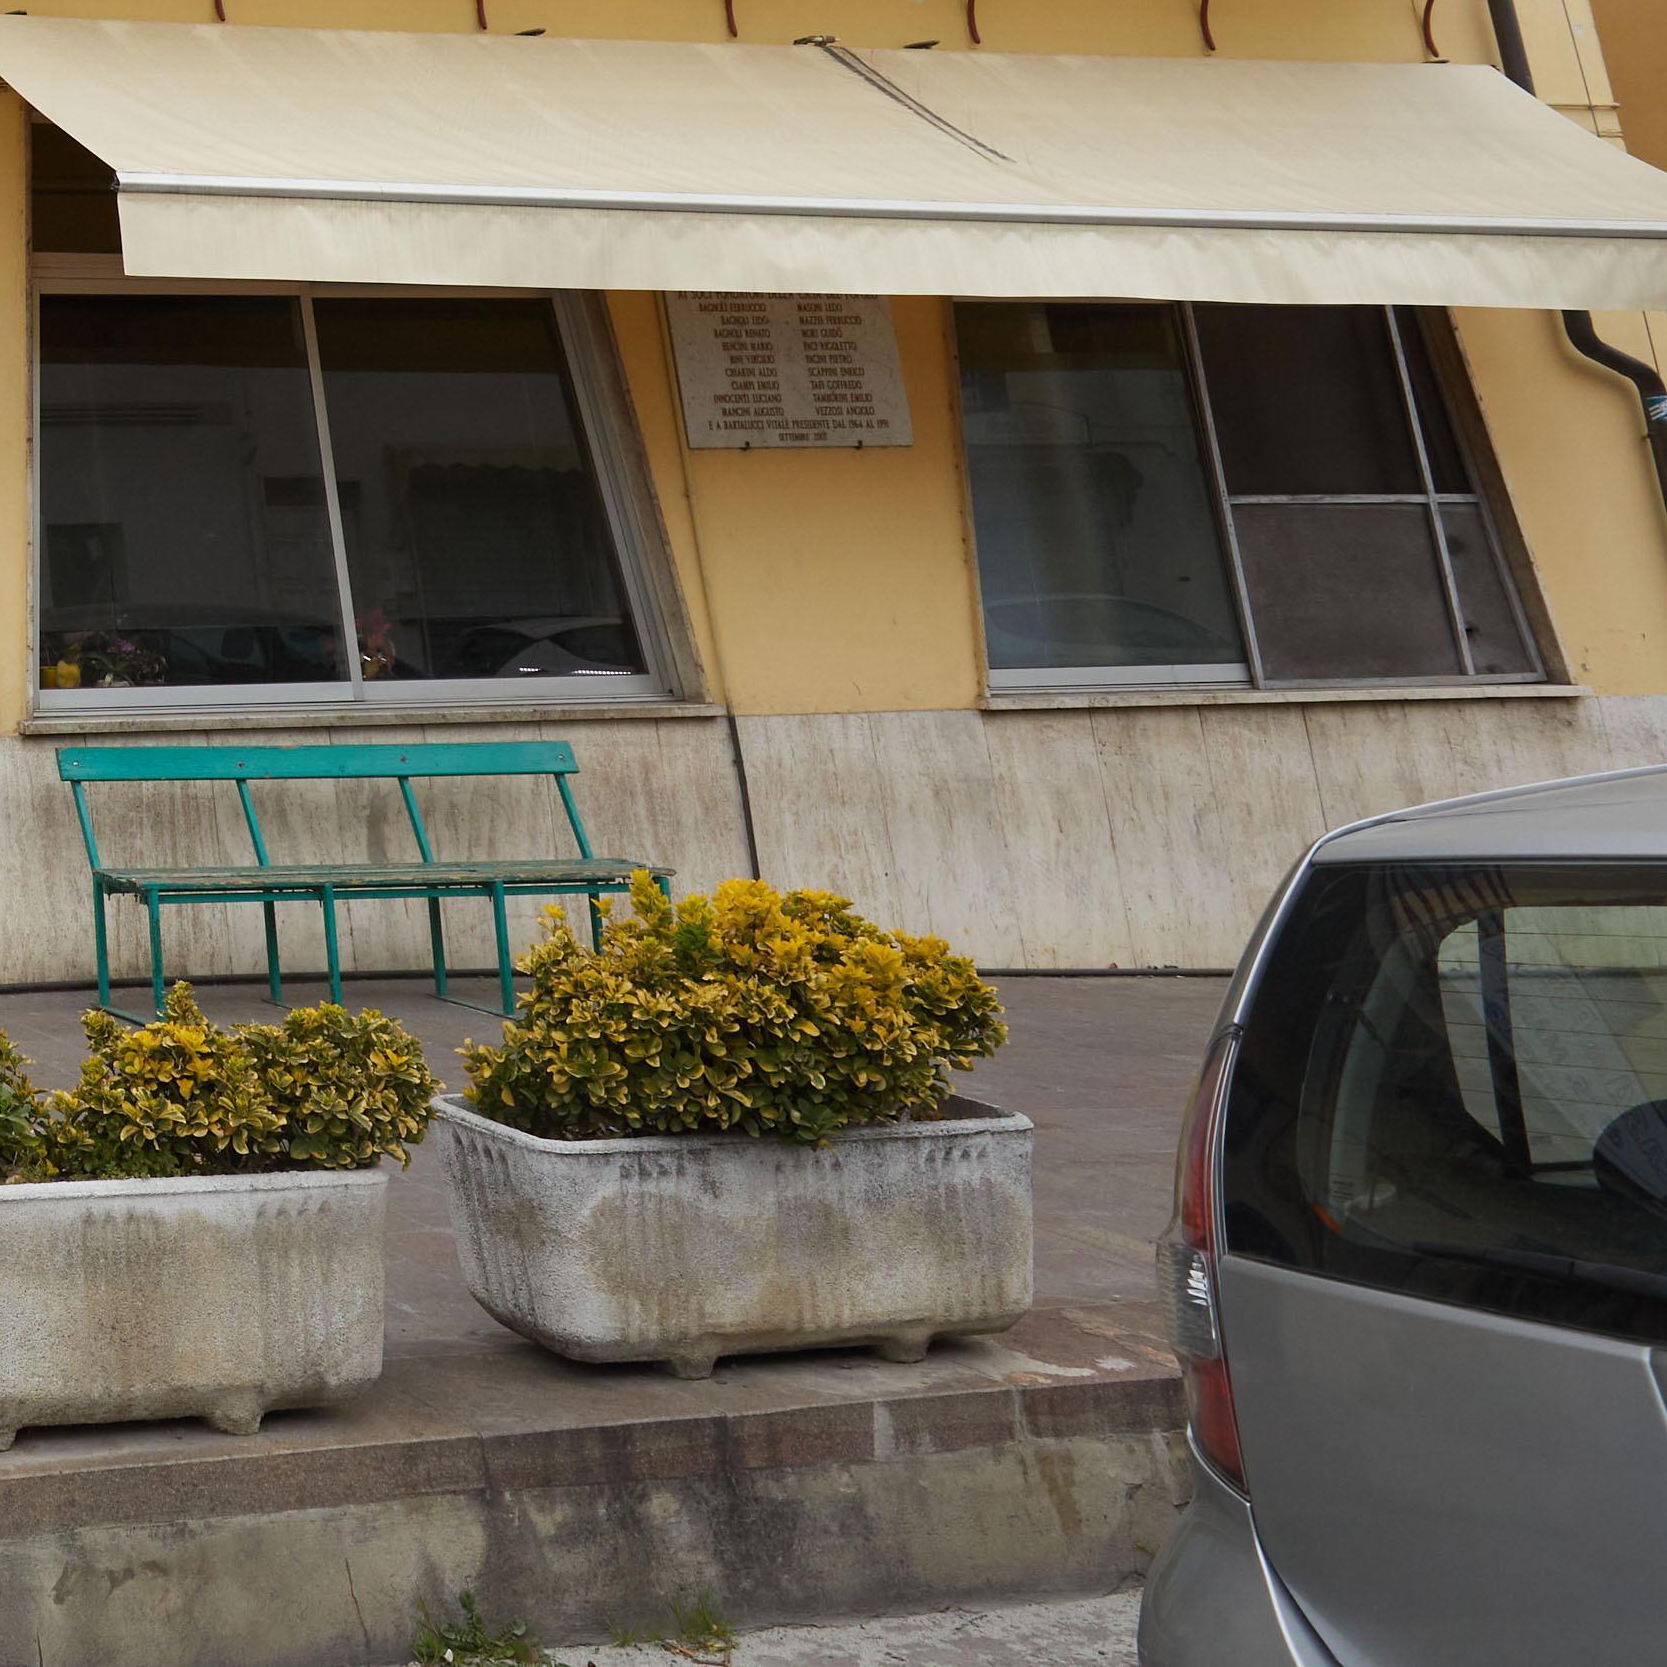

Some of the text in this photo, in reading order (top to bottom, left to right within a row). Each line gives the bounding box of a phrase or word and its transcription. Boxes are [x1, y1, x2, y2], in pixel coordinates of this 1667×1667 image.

[758, 368, 778, 377] ALDO
[753, 394, 782, 403] LUCIANO
[754, 407, 784, 416] AUGUSTO
[767, 420, 789, 430] VITALE
[792, 420, 830, 430] PRESIDENTE
[832, 420, 846, 429] DAL
[866, 420, 875, 429] AL
